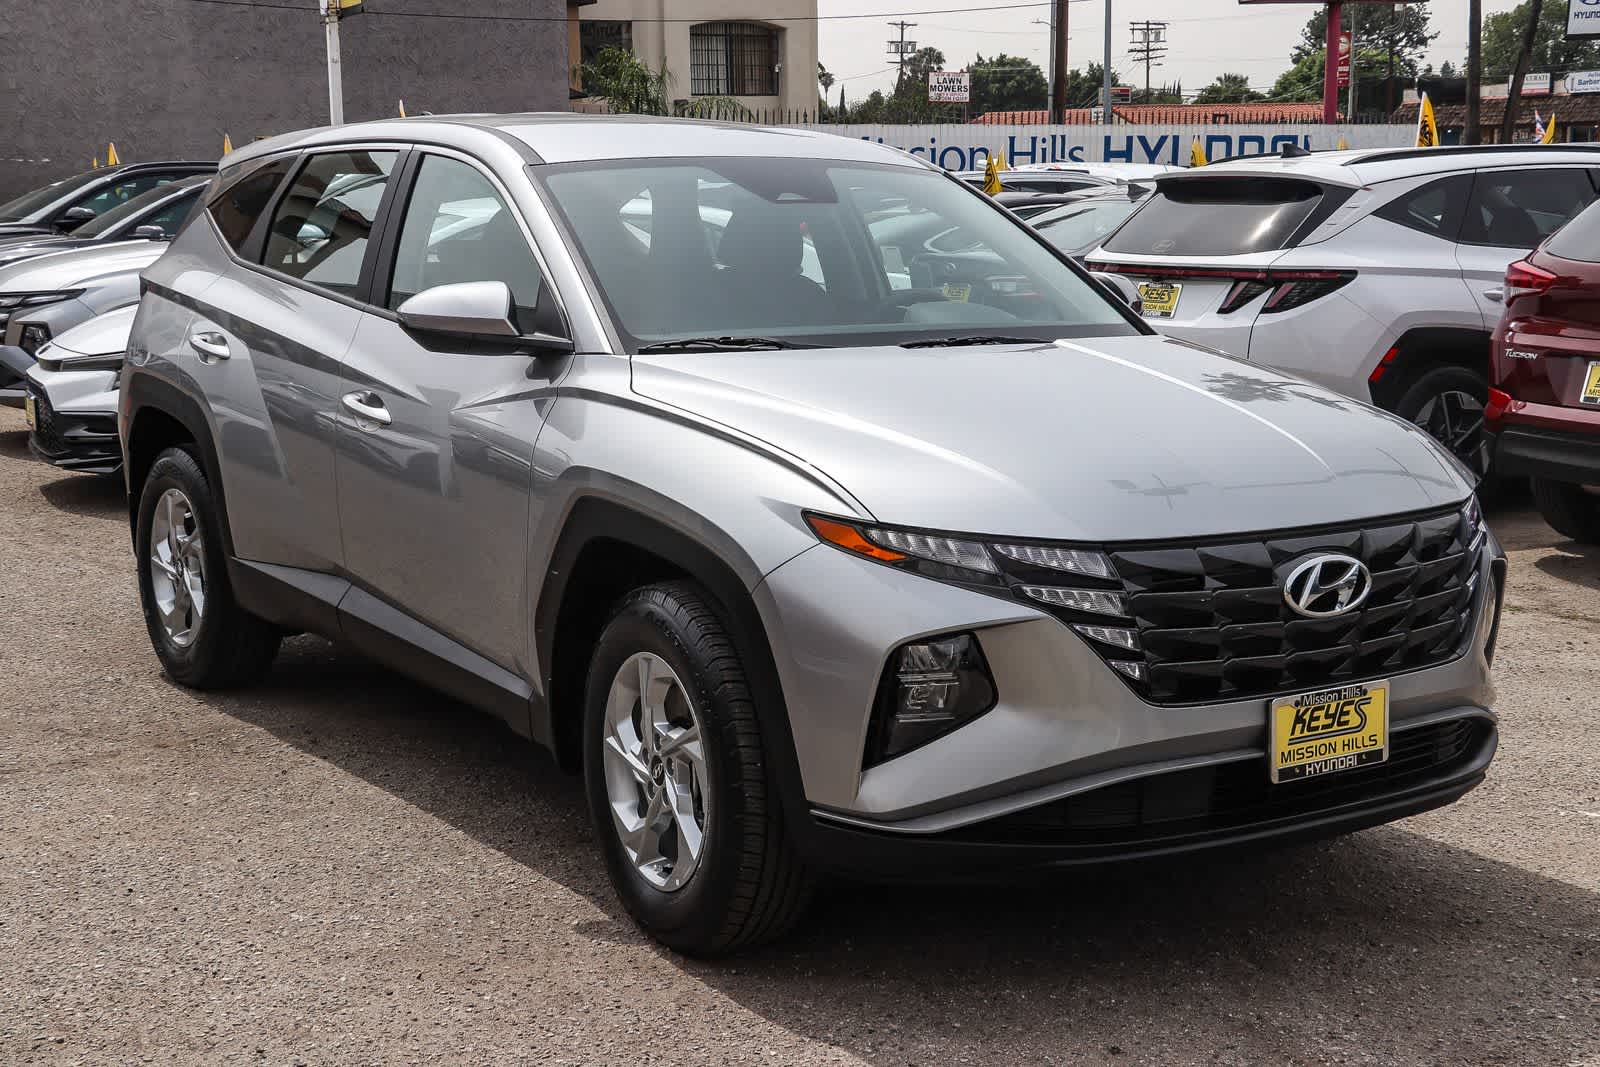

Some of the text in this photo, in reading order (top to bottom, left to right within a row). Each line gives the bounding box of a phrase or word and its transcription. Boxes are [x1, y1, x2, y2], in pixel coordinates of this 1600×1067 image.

[930, 84, 968, 92] MOWERS
[1008, 135, 1085, 168] Hills
[1302, 686, 1361, 706] Mission Hills
[1288, 697, 1373, 743] KEYES
[1280, 734, 1378, 764] MISSION HILLS
[1305, 755, 1358, 776] HYUNDAI
